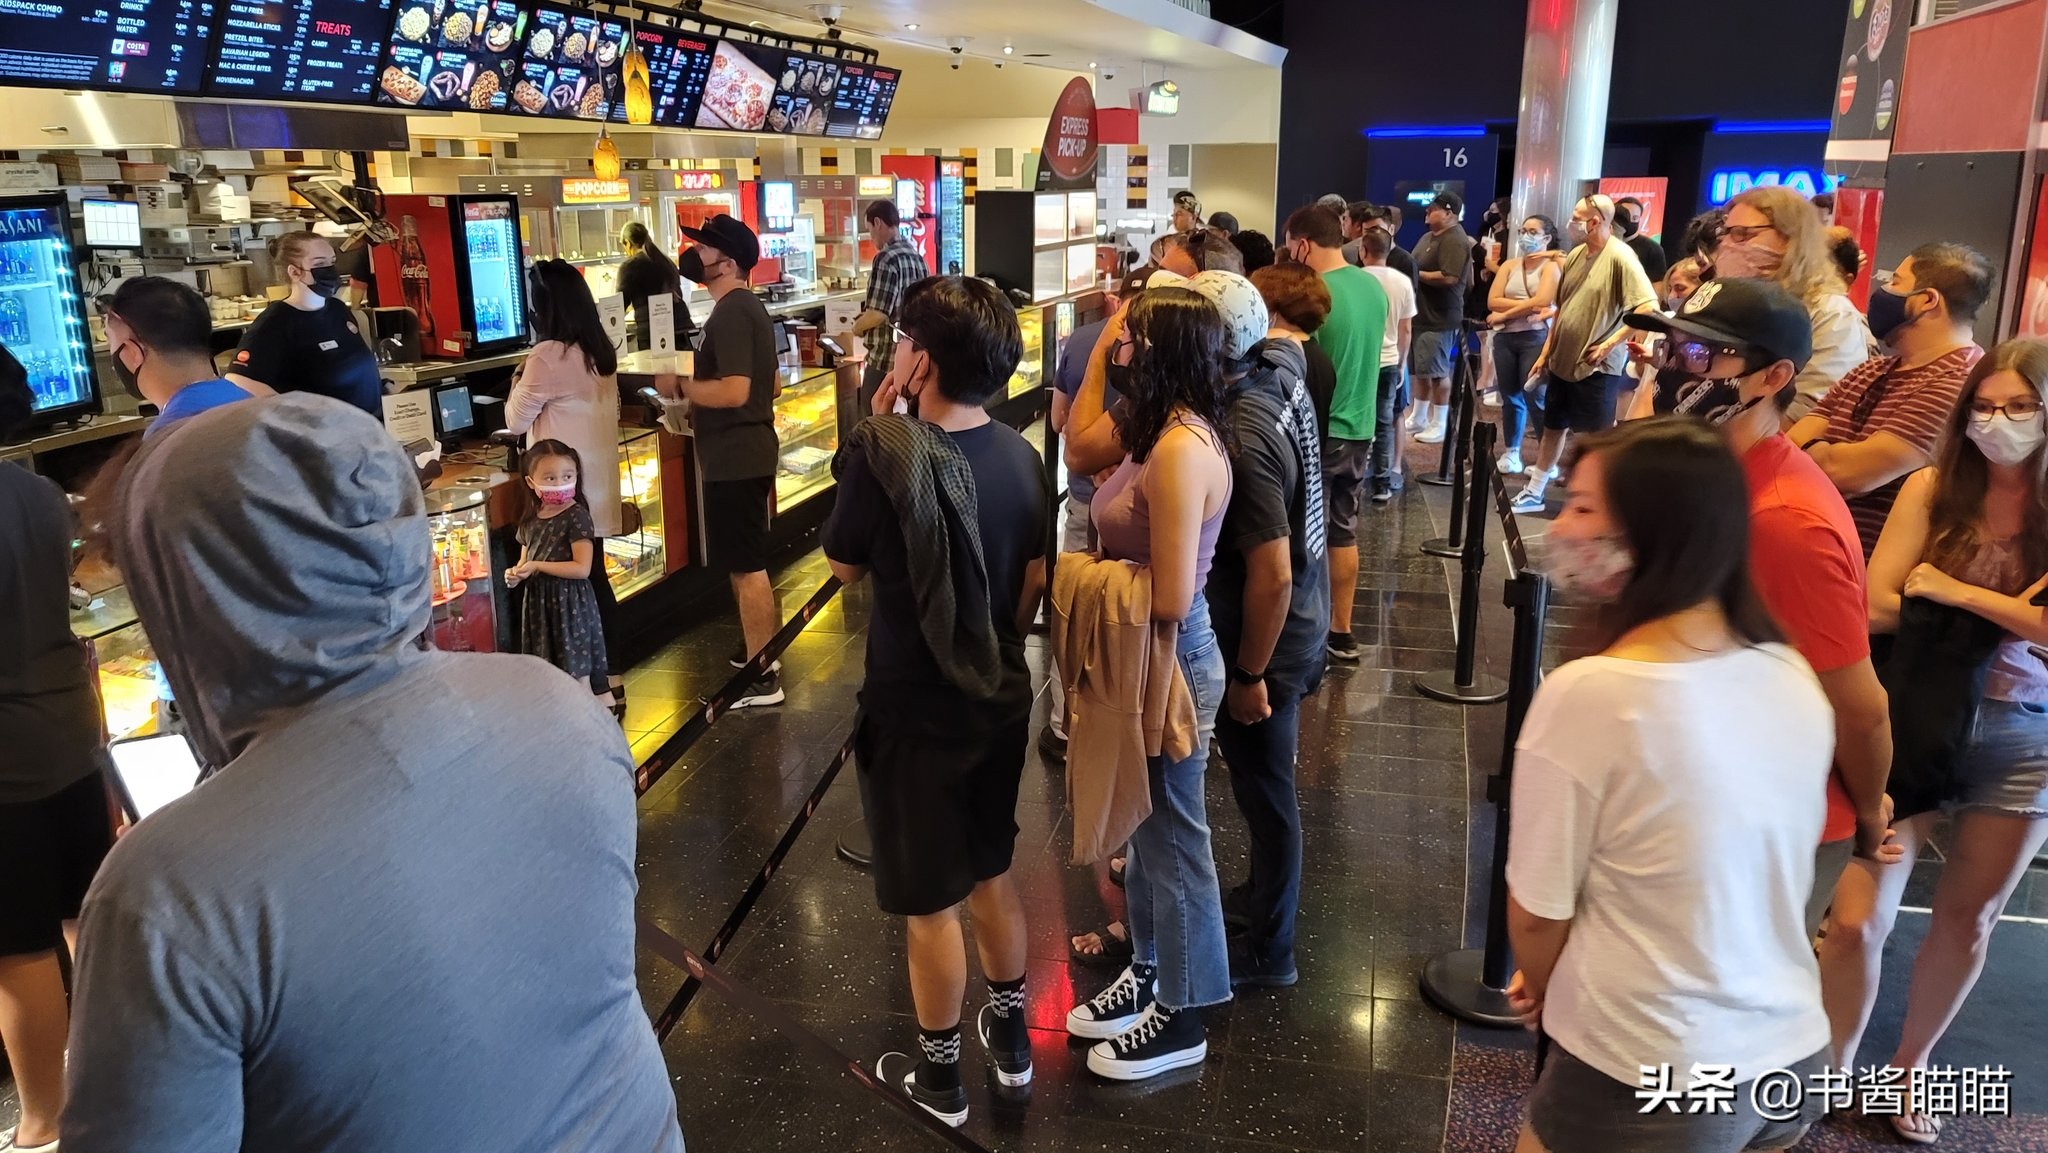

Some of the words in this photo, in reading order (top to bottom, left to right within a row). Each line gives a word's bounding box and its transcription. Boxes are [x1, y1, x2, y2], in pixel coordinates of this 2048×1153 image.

[37, 4, 63, 13] COMBO
[120, 2, 143, 11] DRINKS
[230, 4, 248, 13] CURLY
[248, 6, 264, 15] FRIES
[117, 17, 146, 26] BOTTLED
[227, 18, 262, 29] MOZZARELLA
[263, 22, 281, 31] STICKS
[116, 25, 138, 34] WATER
[315, 20, 352, 36] TREATS
[224, 33, 247, 42] PRETZEL
[248, 35, 263, 43] BITES
[636, 31, 663, 44] POPCORN
[127, 42, 146, 50] COSTA
[311, 39, 328, 48] CANDY
[221, 47, 248, 56] BAVARIAN
[218, 61, 231, 70] MAC
[236, 63, 256, 71] CHEESE
[306, 59, 326, 67] FROZEN
[326, 60, 343, 69] TREATS
[302, 79, 334, 88] GLUTEN-FREE
[1060, 116, 1089, 136] EXPRESS
[1057, 137, 1087, 158] PICK-UP
[1443, 147, 1468, 168] 16
[574, 181, 620, 196] POPCORN
